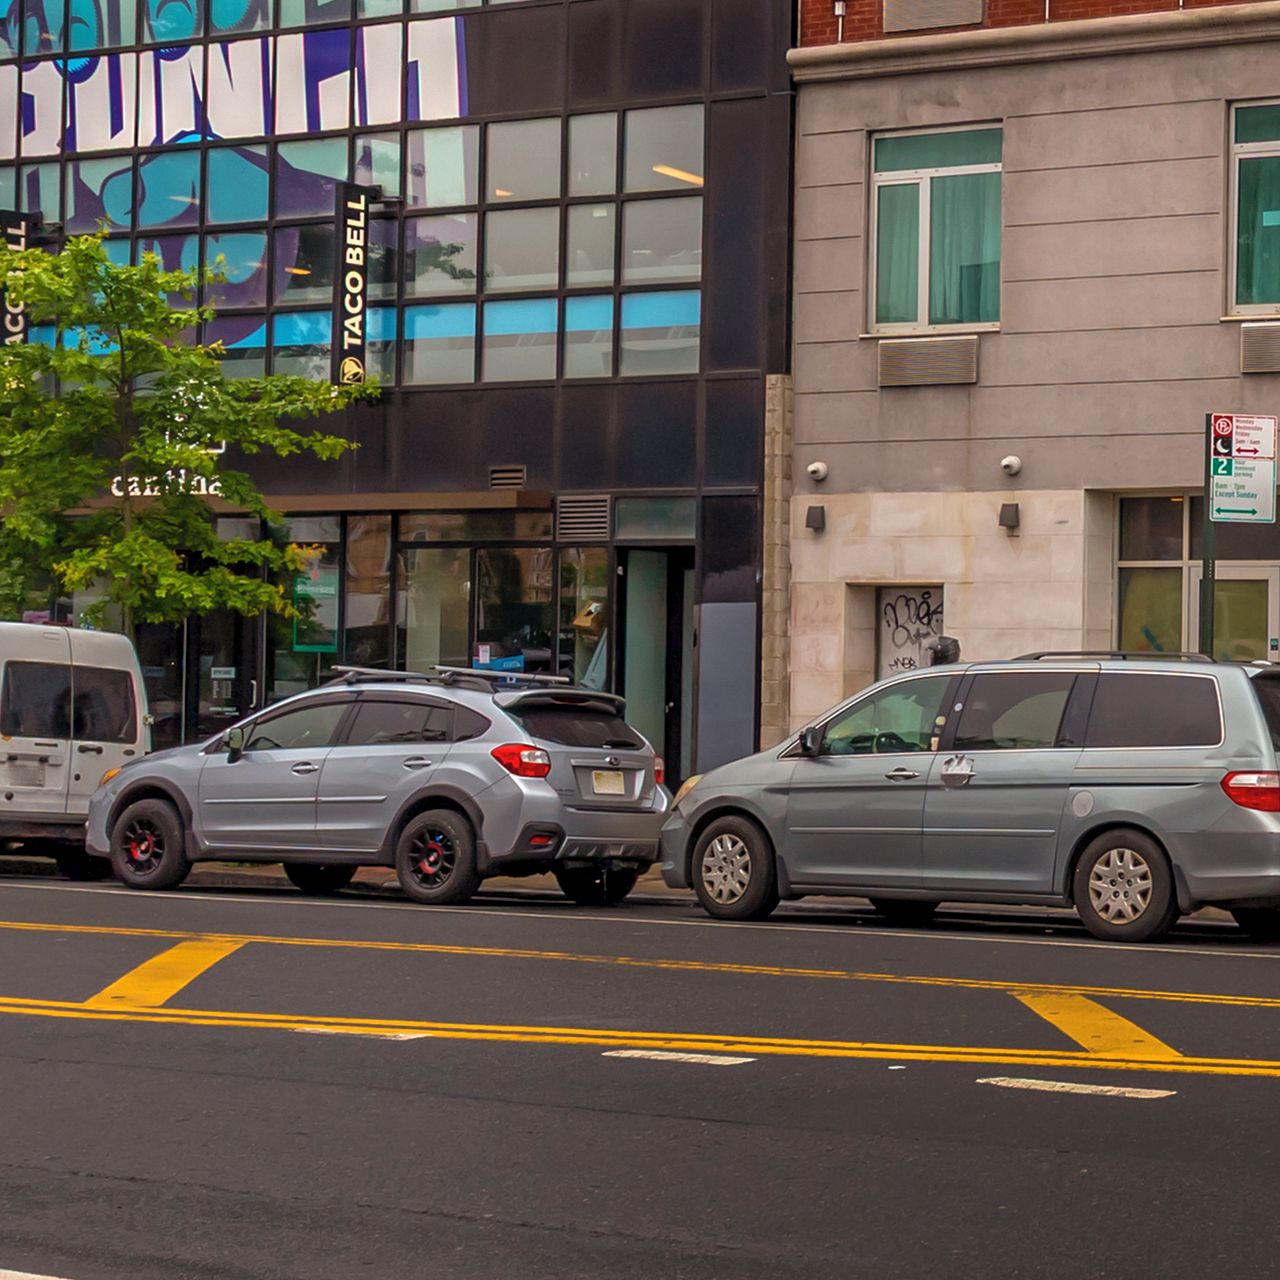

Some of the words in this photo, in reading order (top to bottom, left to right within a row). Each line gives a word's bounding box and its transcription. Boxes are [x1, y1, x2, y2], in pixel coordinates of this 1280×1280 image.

[345, 194, 366, 266] BELL
[343, 270, 364, 350] TACO
[1217, 458, 1228, 474] 2
